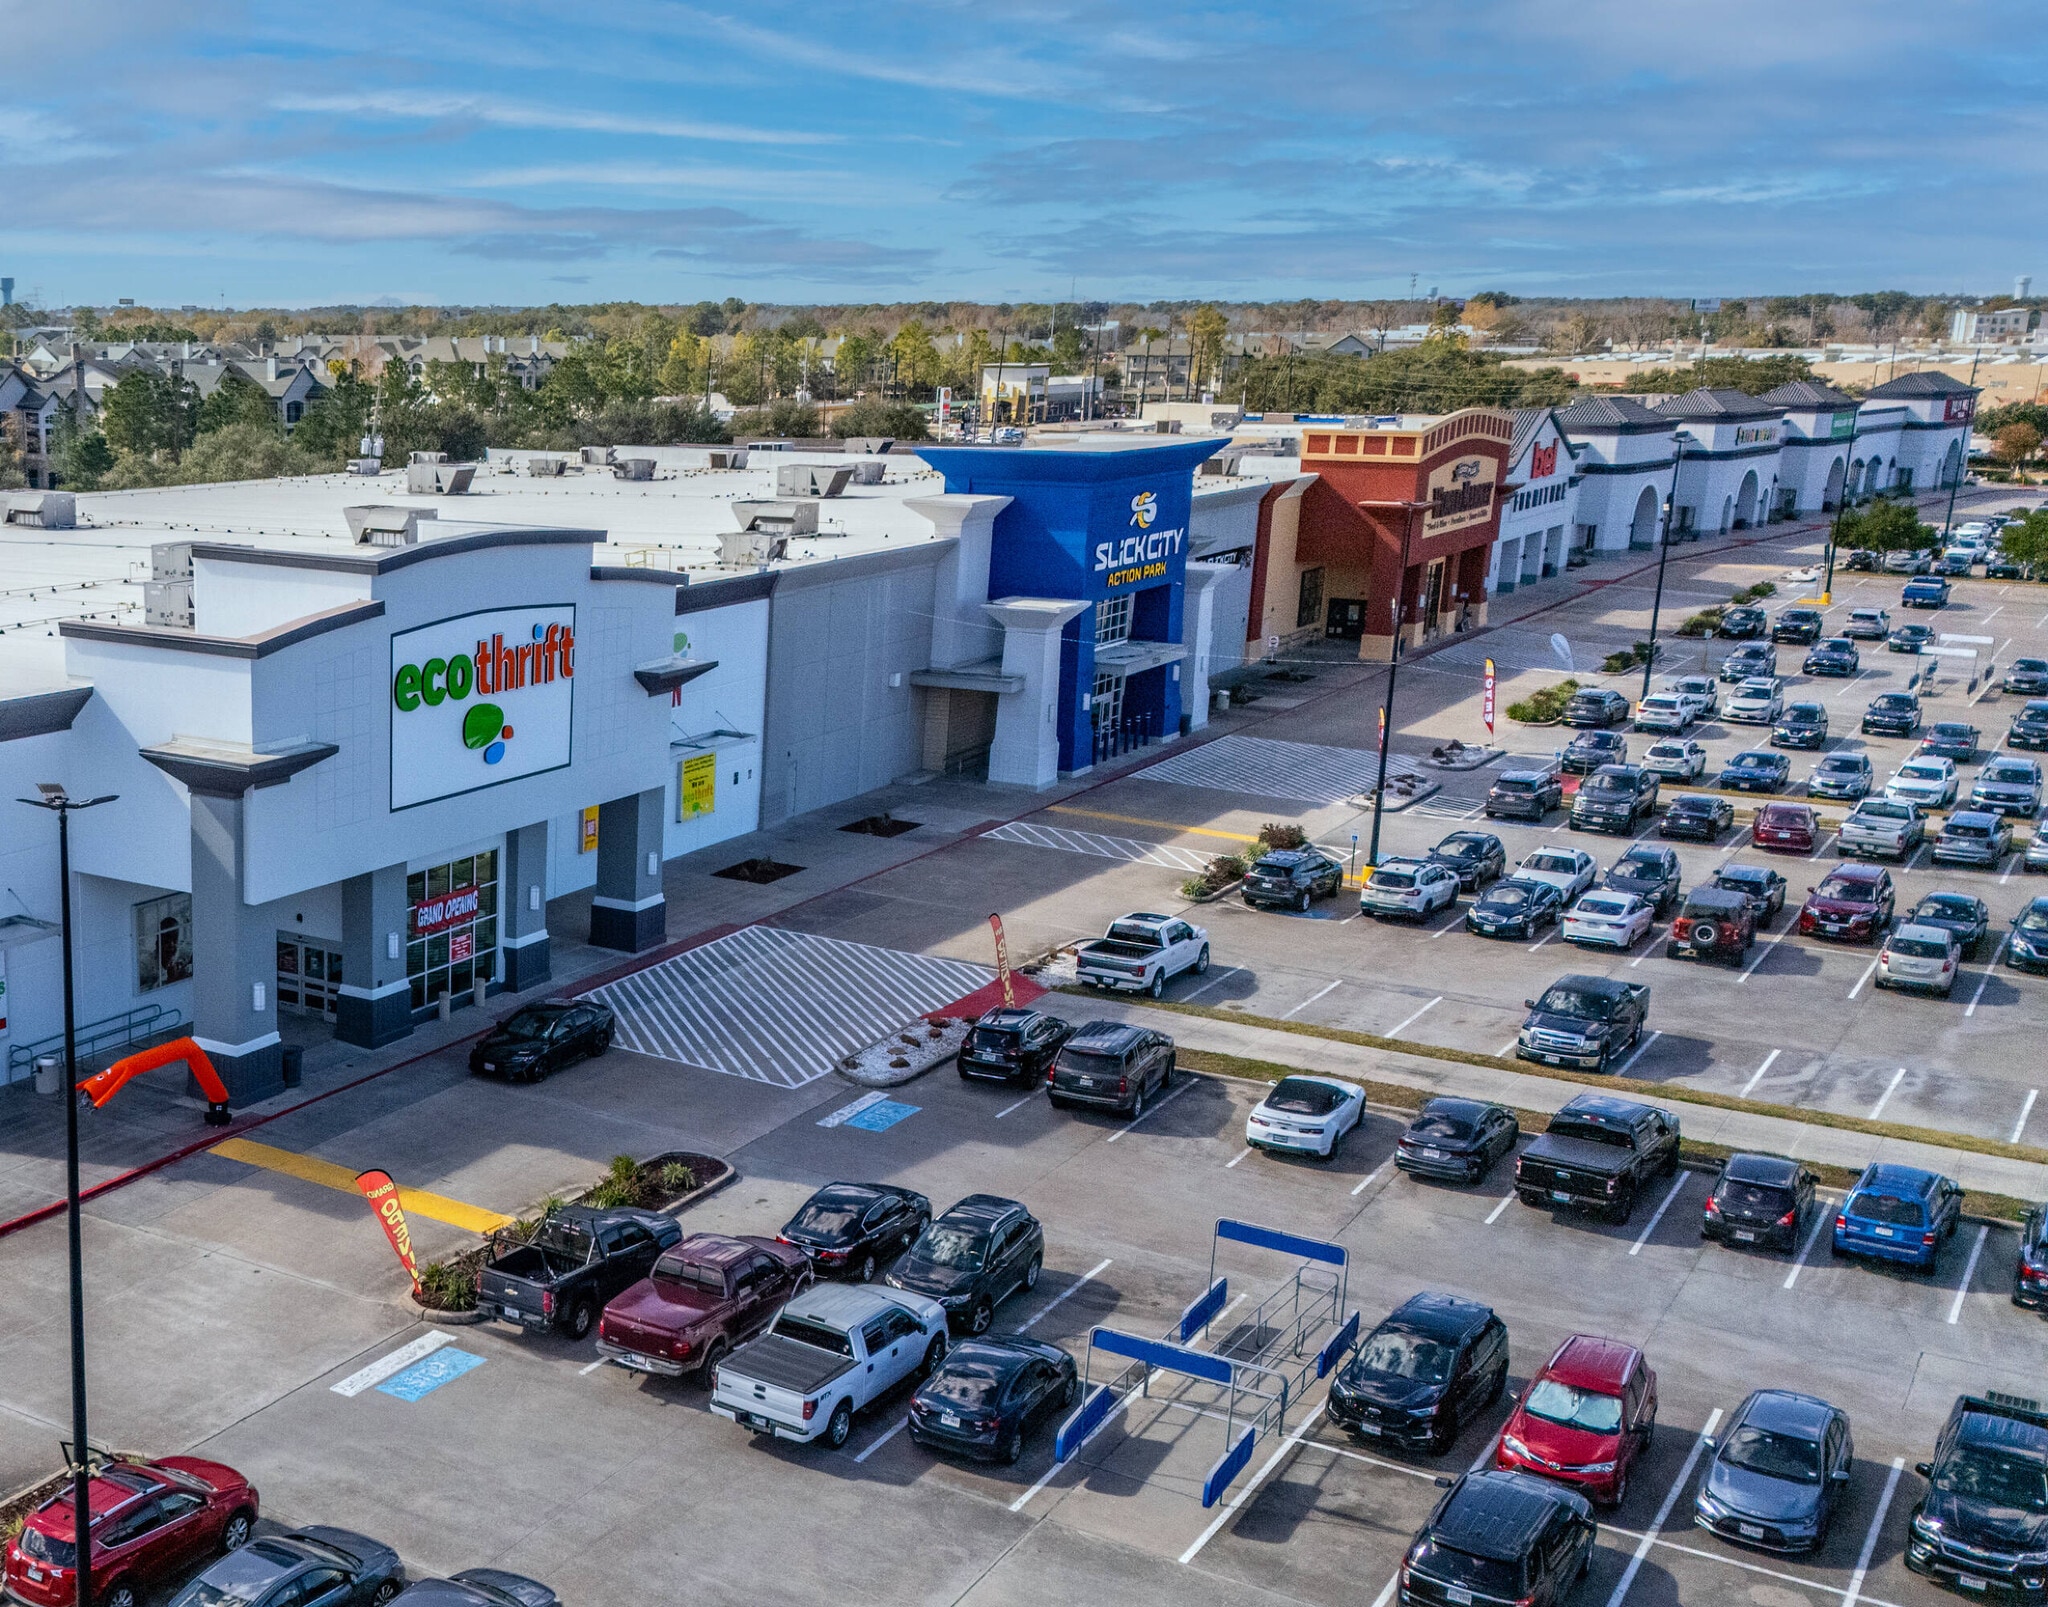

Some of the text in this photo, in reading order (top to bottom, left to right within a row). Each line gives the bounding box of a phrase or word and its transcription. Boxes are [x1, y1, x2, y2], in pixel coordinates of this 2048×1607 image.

[1530, 437, 1559, 479] bel
[1107, 561, 1167, 587] ACTION PARK
[417, 889, 478, 928] GRAND OPENING
